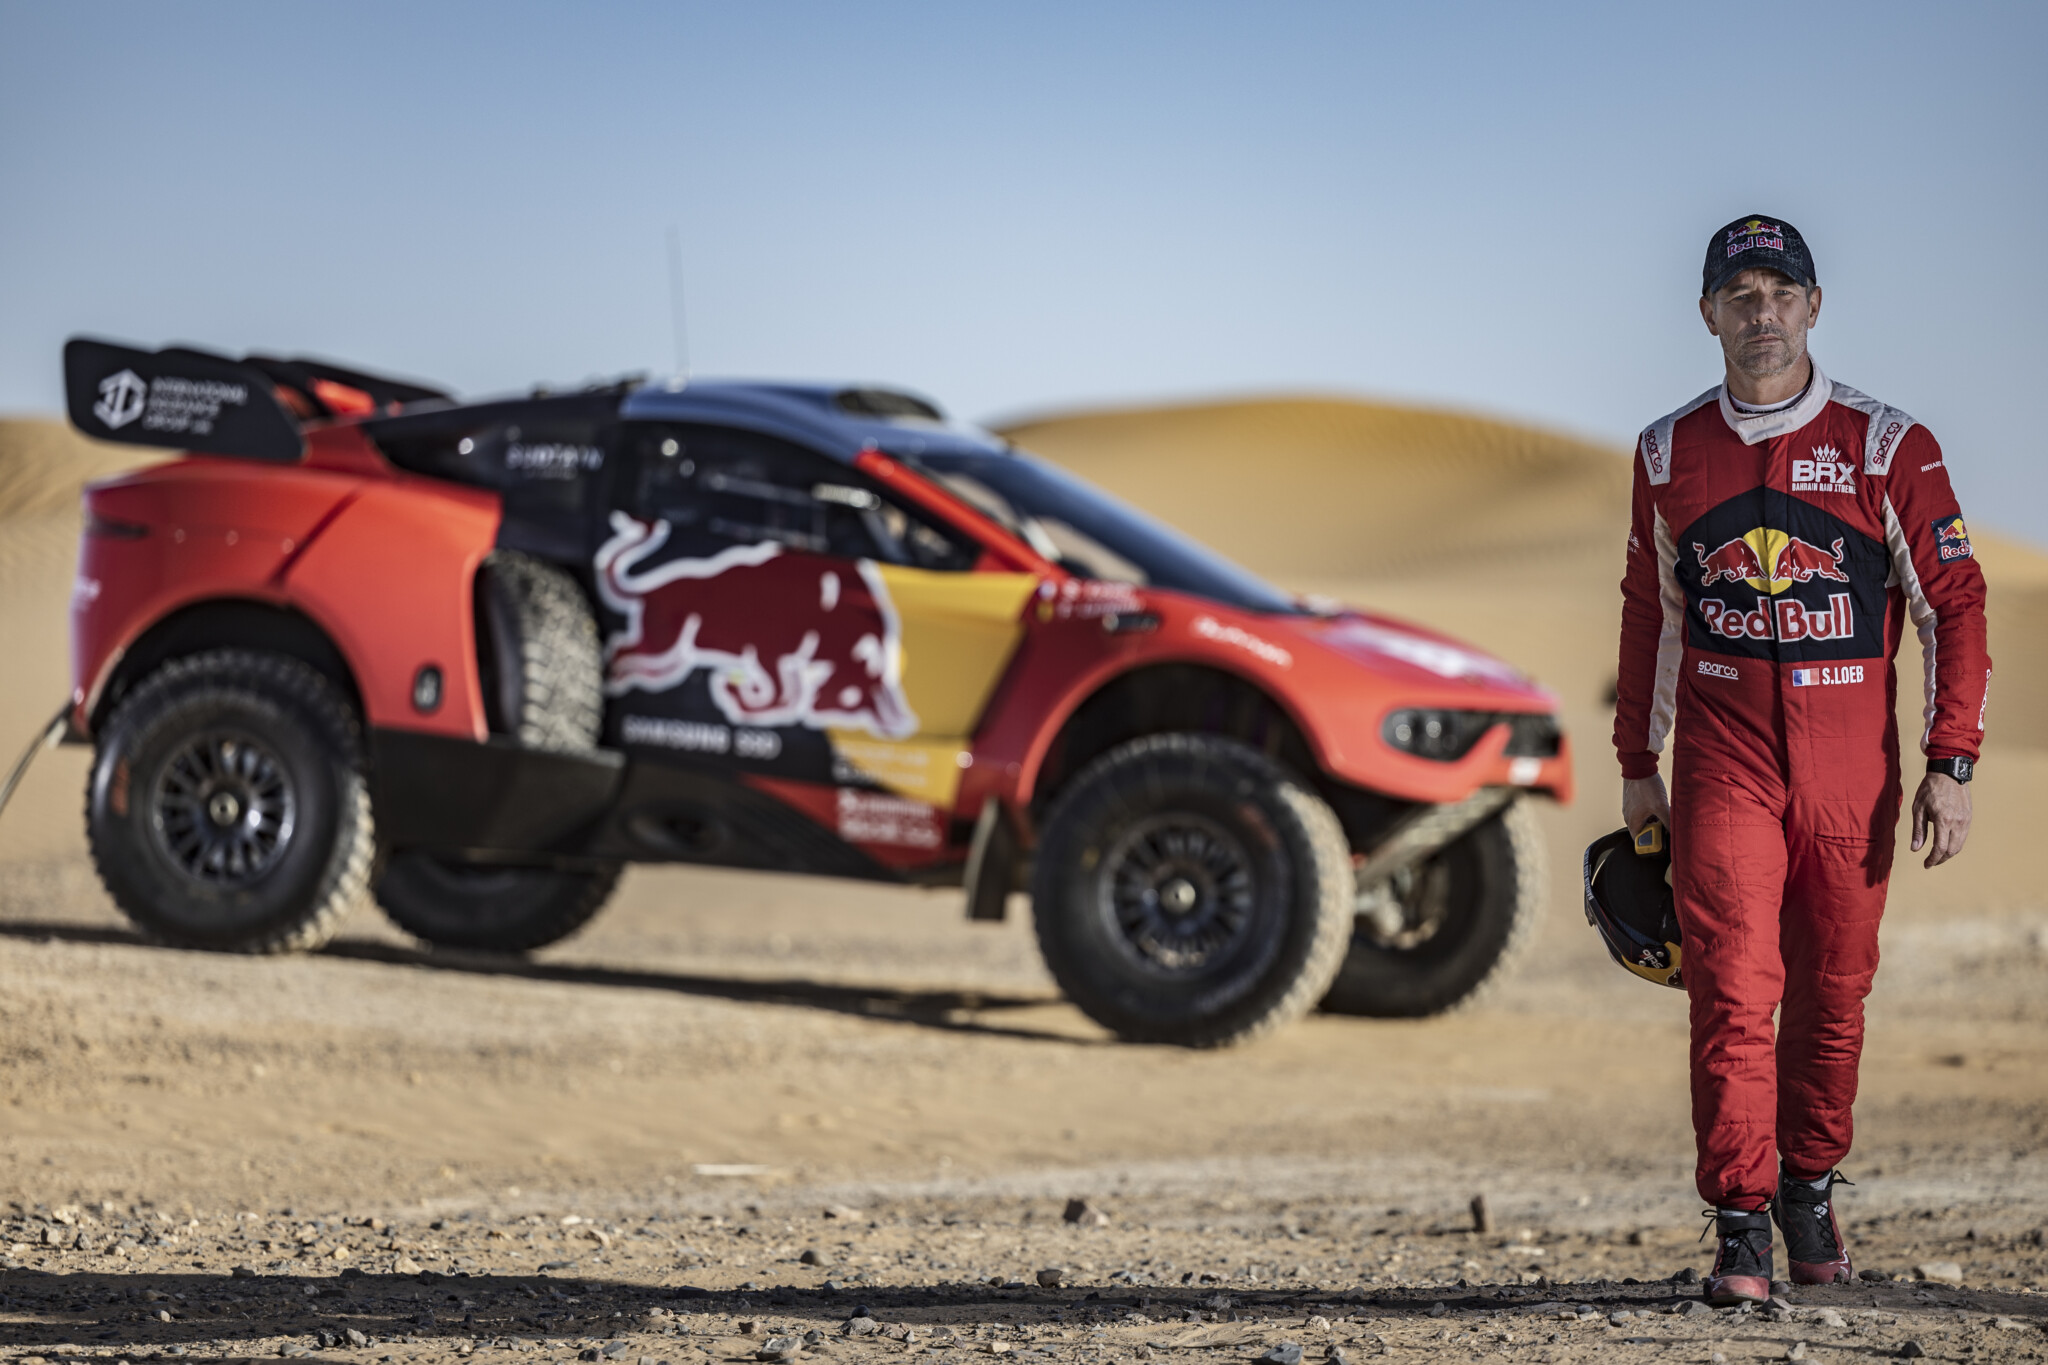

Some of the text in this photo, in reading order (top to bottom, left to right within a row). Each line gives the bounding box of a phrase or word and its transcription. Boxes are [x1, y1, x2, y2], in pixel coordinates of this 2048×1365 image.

[1727, 236, 1783, 257] Red Bull
[1645, 429, 1663, 475] sparco
[1872, 421, 1903, 467] sparco
[1792, 460, 1856, 484] BRX
[1792, 483, 1818, 492] BAHRAIN
[1819, 483, 1833, 493] RAID
[1699, 592, 1854, 643] Red Bull
[1697, 660, 1739, 680] sparco
[1822, 665, 1864, 685] S.LOEB
